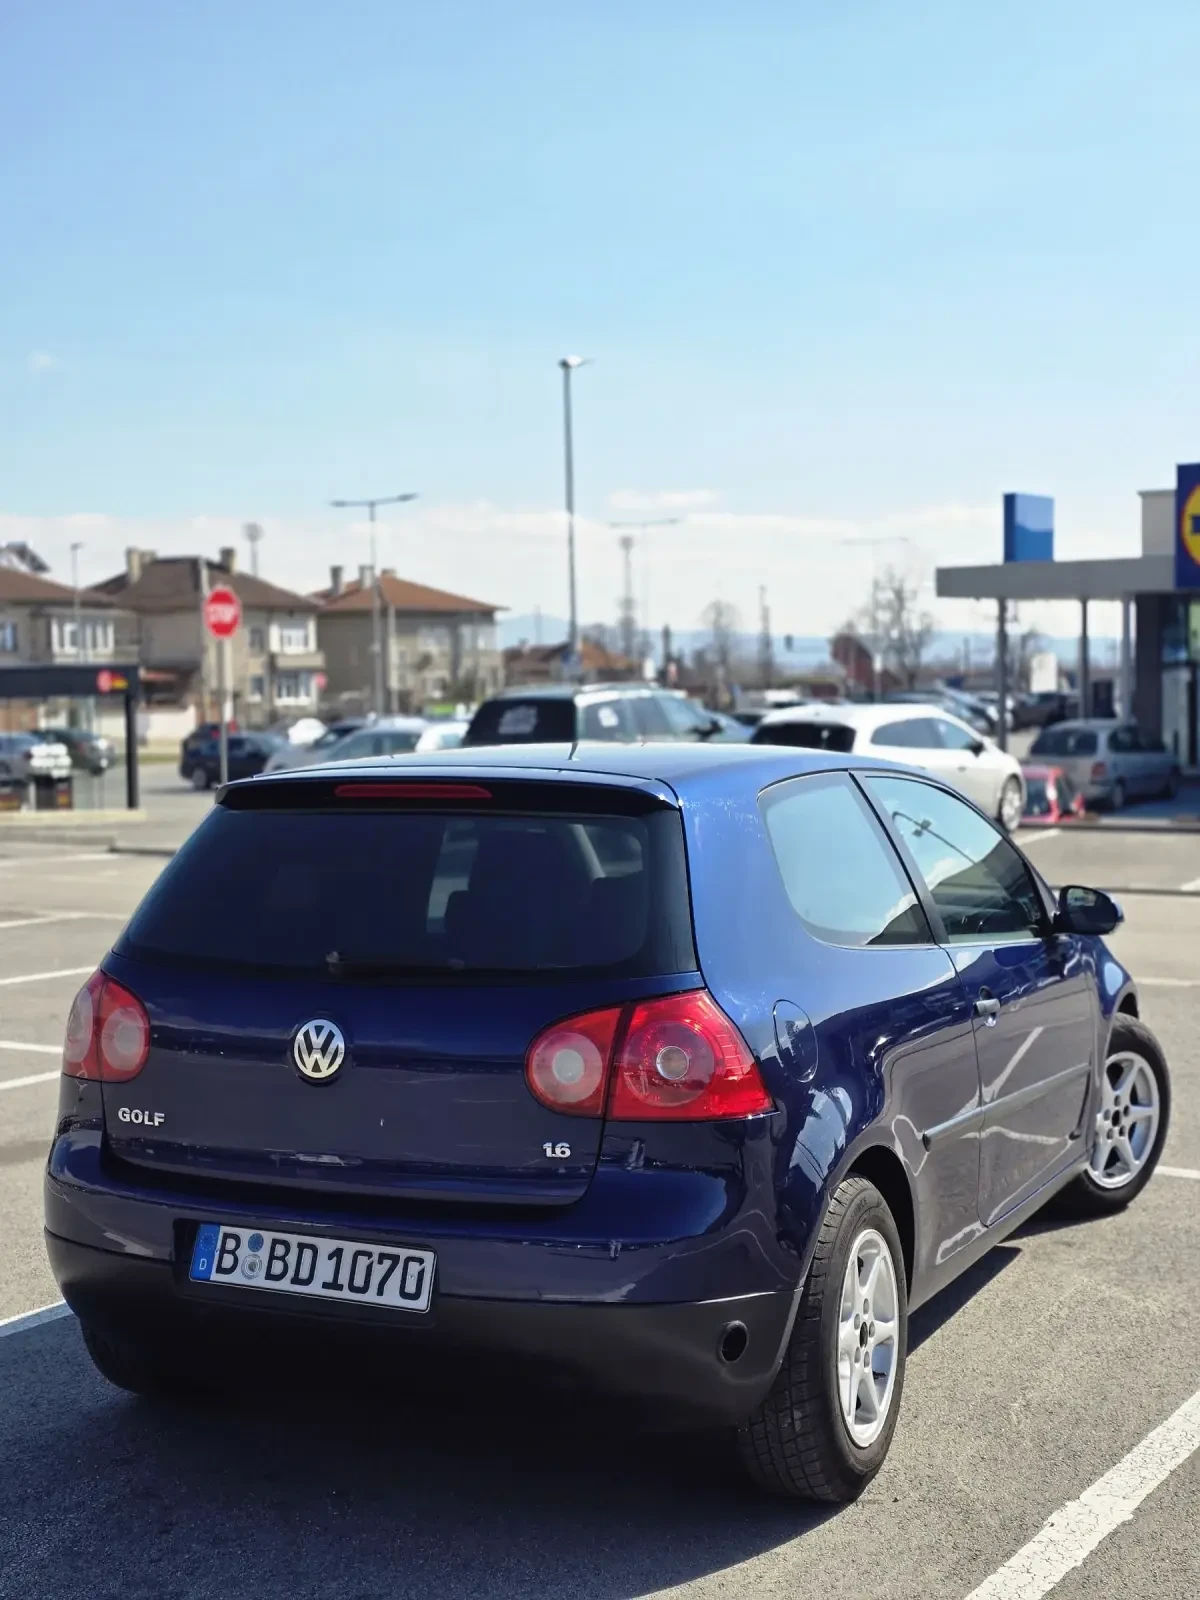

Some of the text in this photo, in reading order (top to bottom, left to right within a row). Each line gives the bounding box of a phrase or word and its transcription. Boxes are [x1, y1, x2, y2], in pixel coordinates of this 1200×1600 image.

[118, 1107, 165, 1127] GOLF
[215, 1232, 242, 1275] B
[199, 1258, 208, 1270] D
